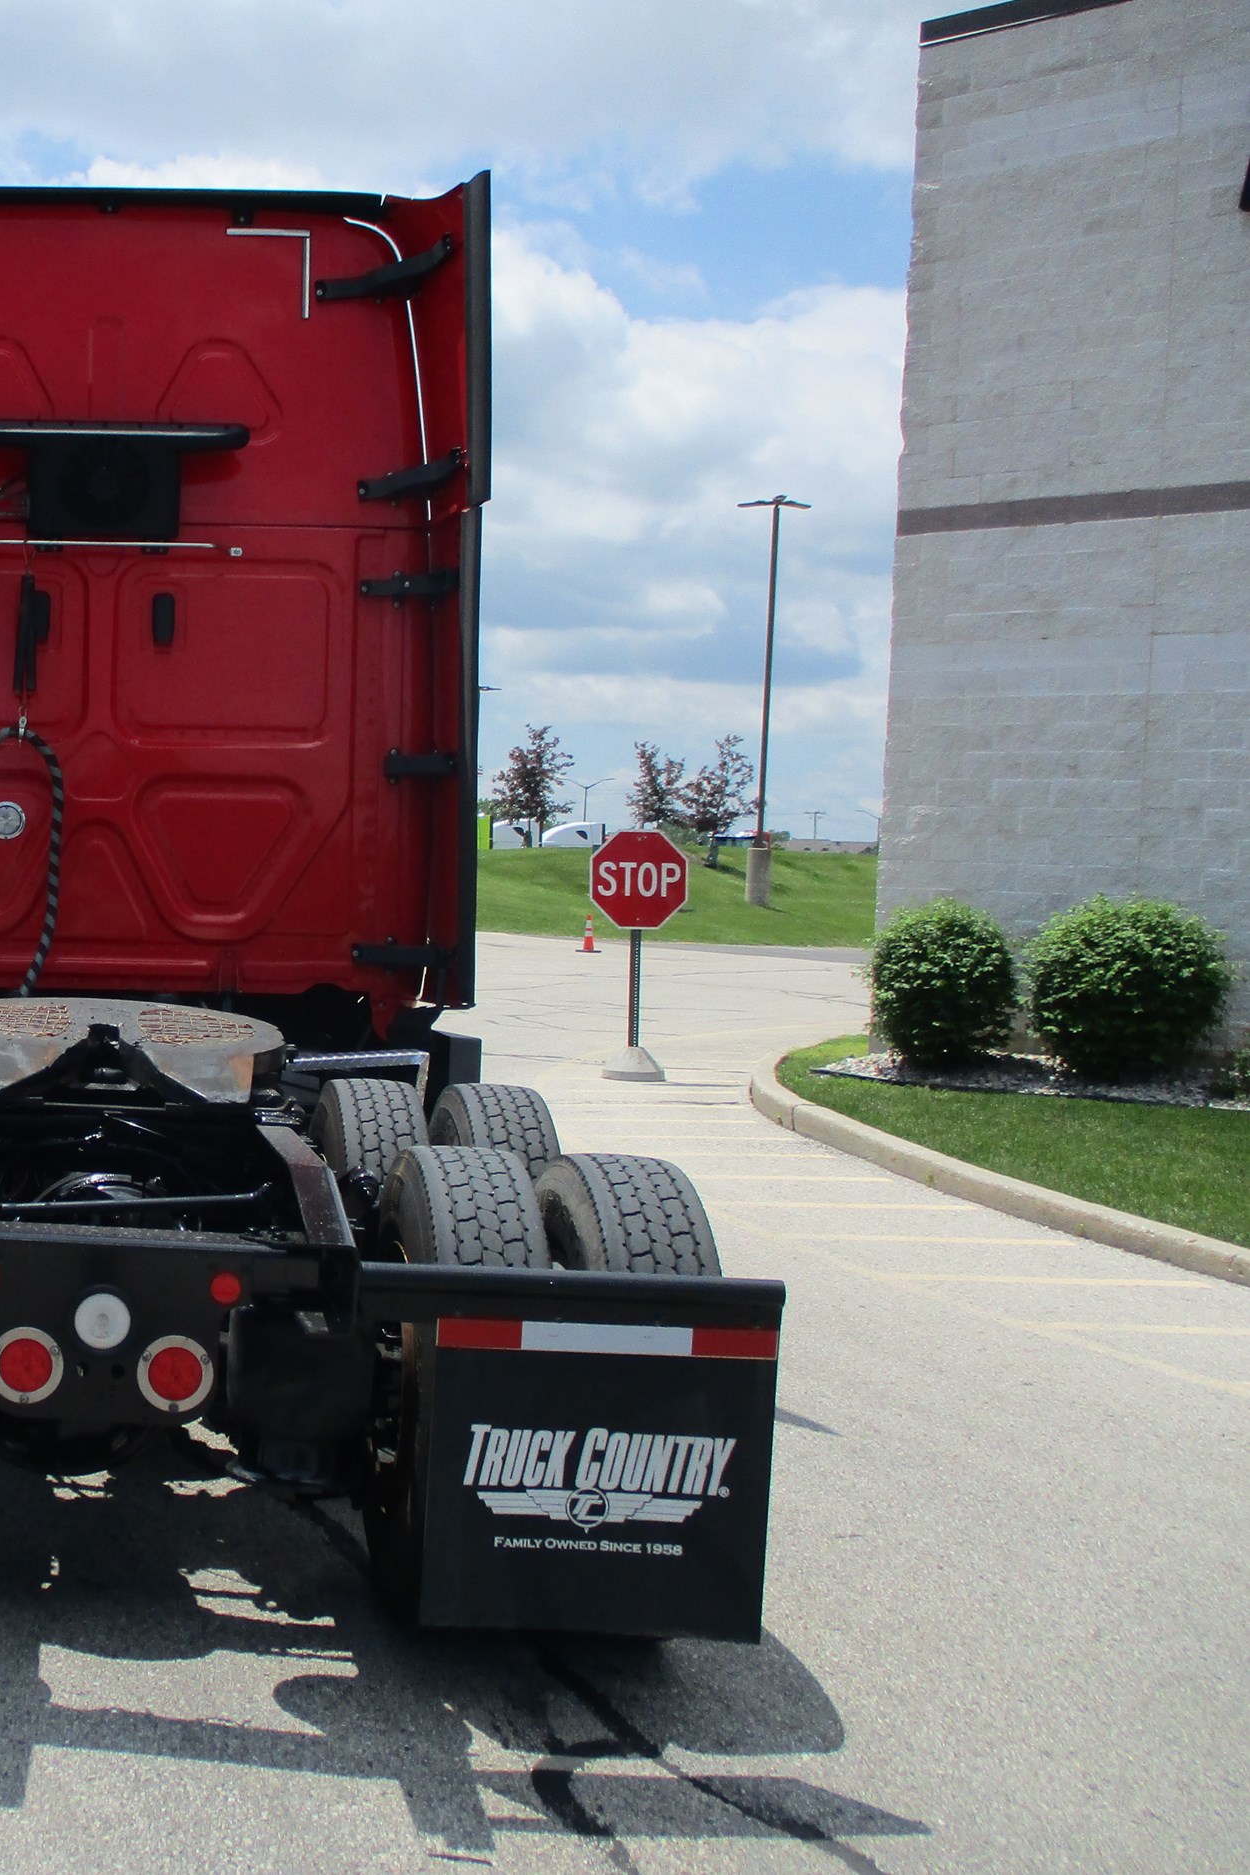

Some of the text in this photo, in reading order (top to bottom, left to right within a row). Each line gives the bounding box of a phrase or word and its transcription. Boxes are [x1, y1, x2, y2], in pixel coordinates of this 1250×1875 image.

[597, 861, 682, 897] STOP
[463, 1424, 737, 1497] TRUCK COUNTRY
[493, 1536, 683, 1557] FAMILY OWNED SINCE 1958
